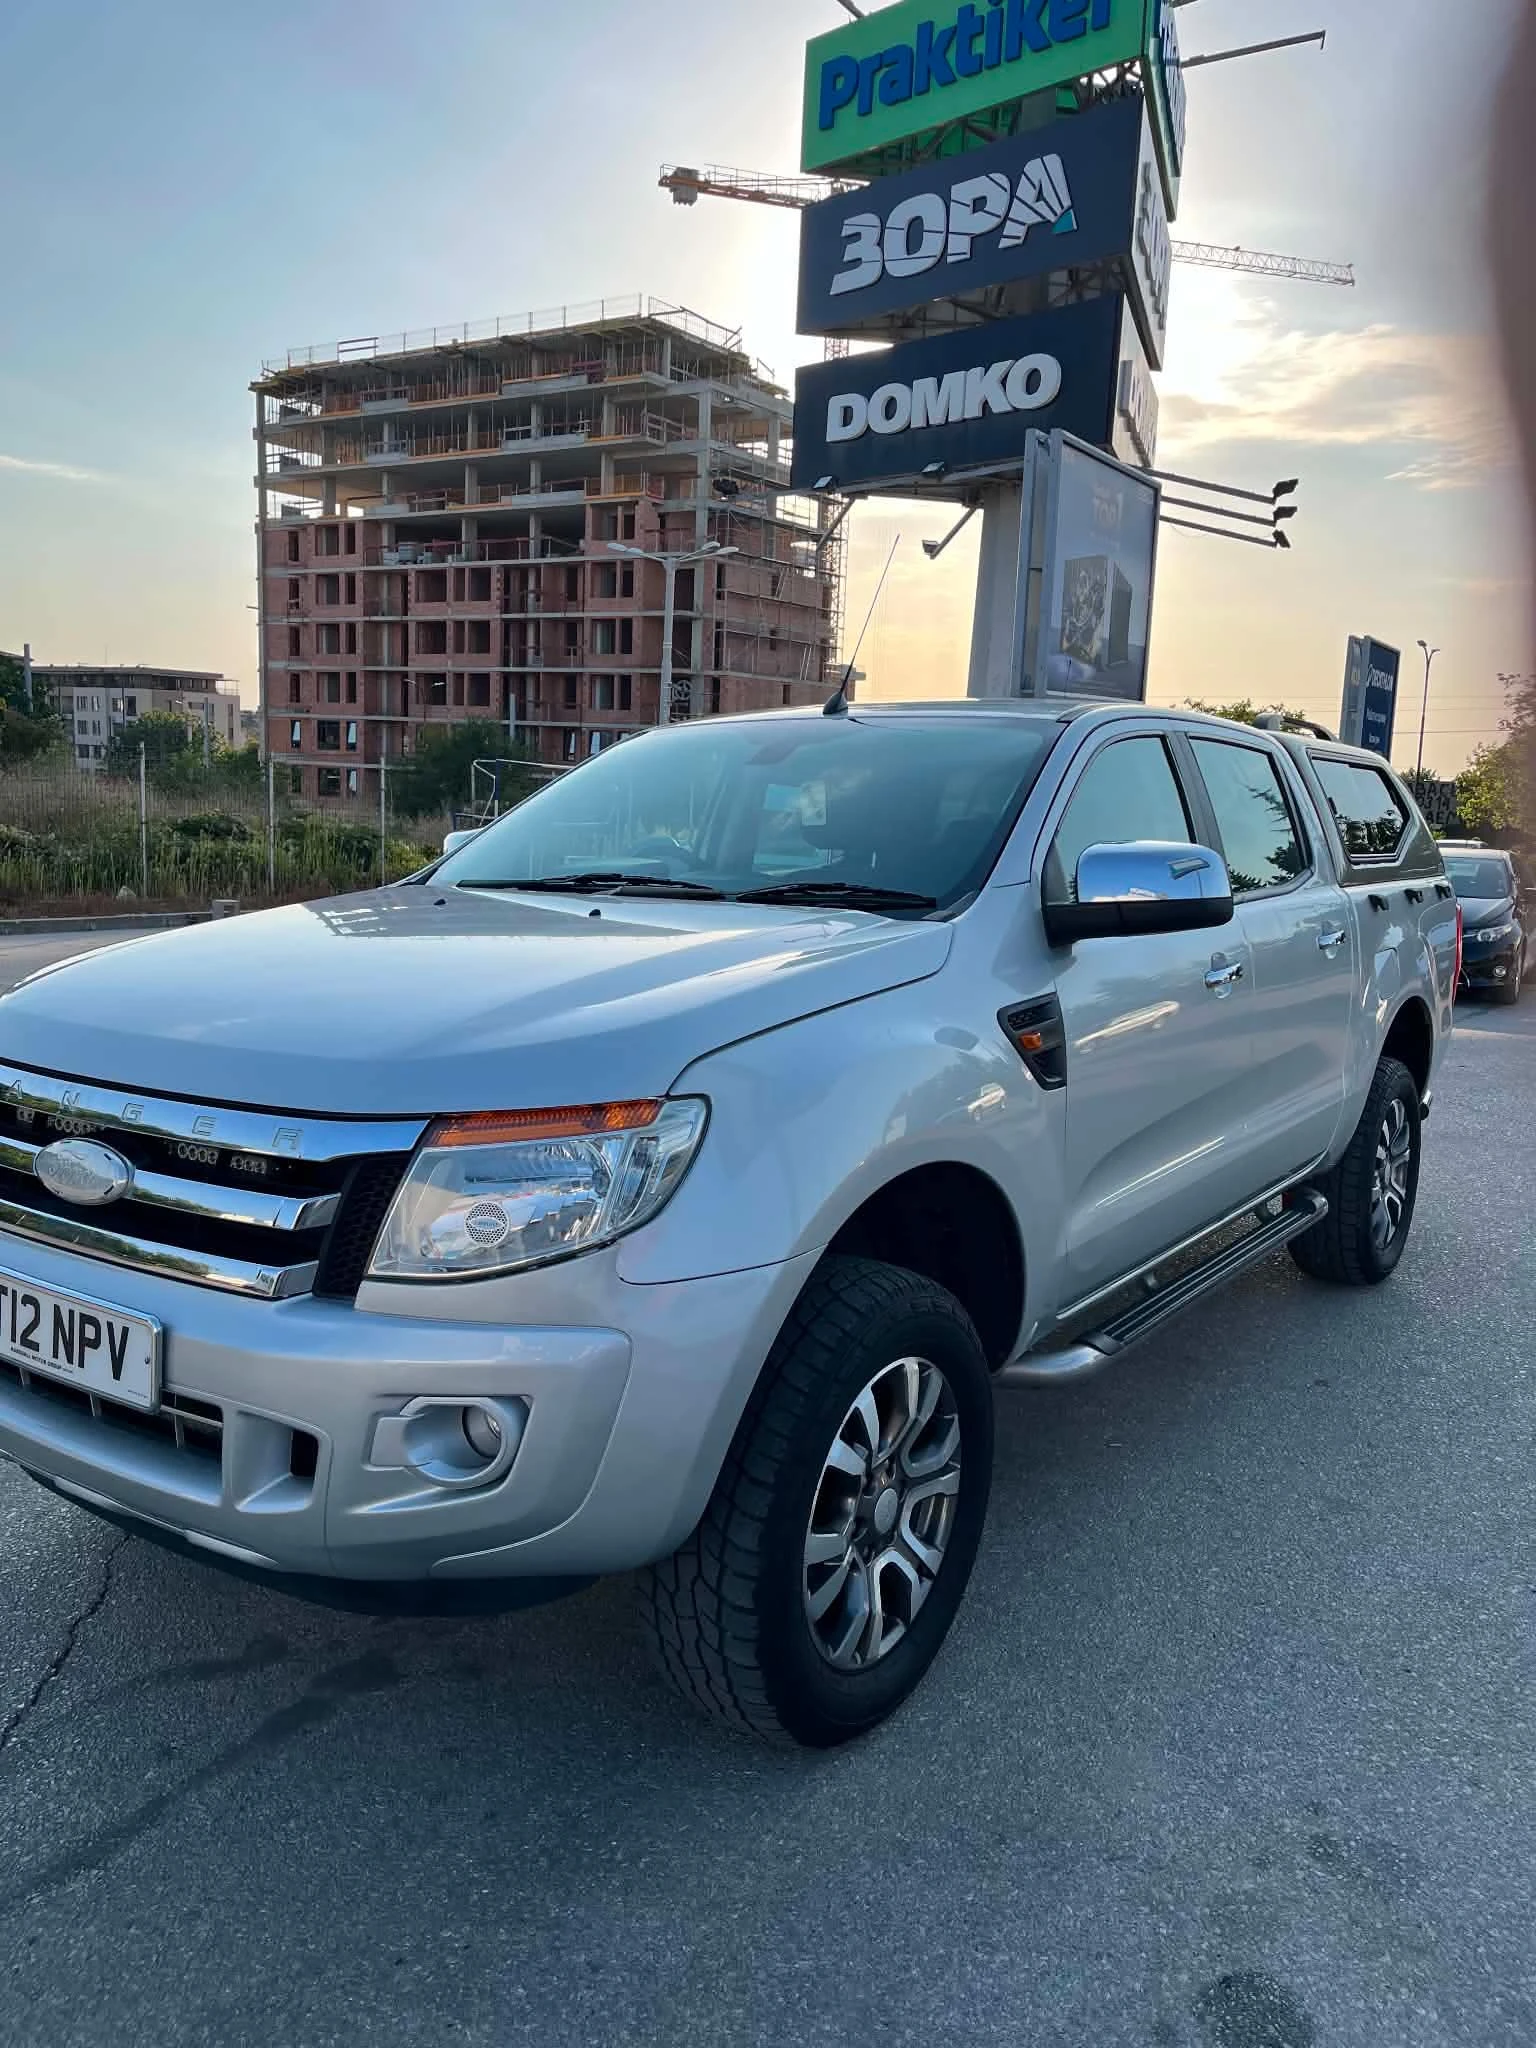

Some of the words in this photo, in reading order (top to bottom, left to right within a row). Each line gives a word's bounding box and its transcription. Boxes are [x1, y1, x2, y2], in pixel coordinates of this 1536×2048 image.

[829, 153, 1077, 295] ЗОРА
[825, 353, 1062, 443] DOMKO
[52, 1303, 130, 1381] NPV
